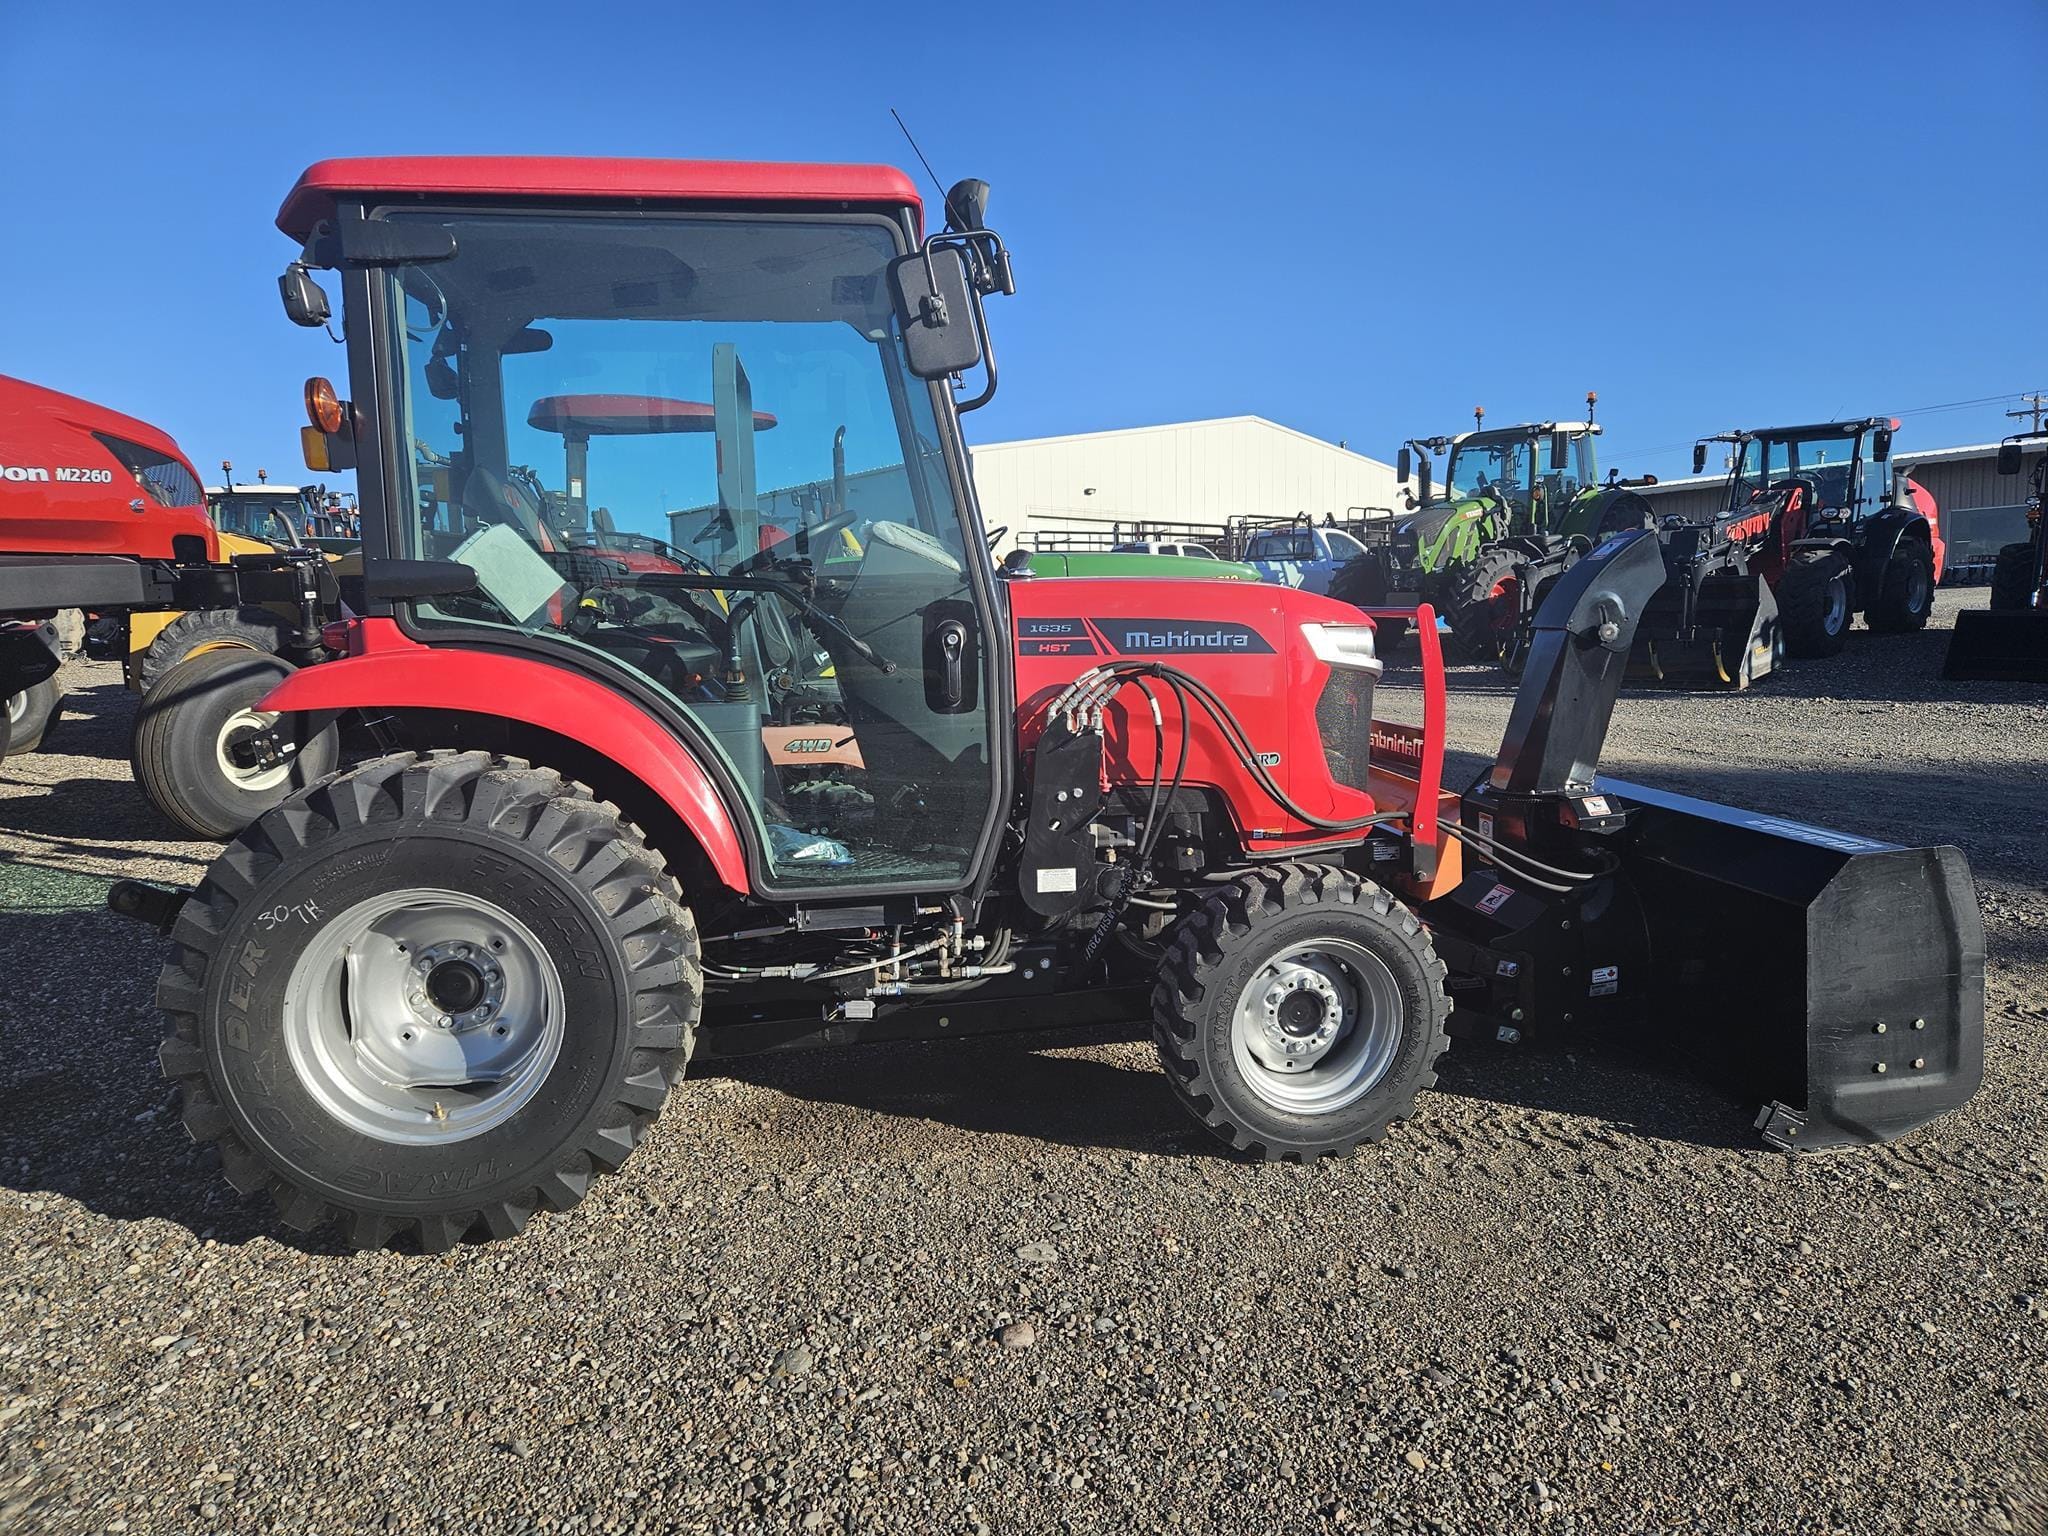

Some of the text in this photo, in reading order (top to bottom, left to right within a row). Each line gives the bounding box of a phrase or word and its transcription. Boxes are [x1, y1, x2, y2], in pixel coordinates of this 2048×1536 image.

[56, 467, 112, 483] M2260
[1030, 624, 1072, 633] 1635
[1125, 629, 1249, 648] Mahindra
[1038, 643, 1071, 652] HST
[784, 738, 832, 754] 4WD
